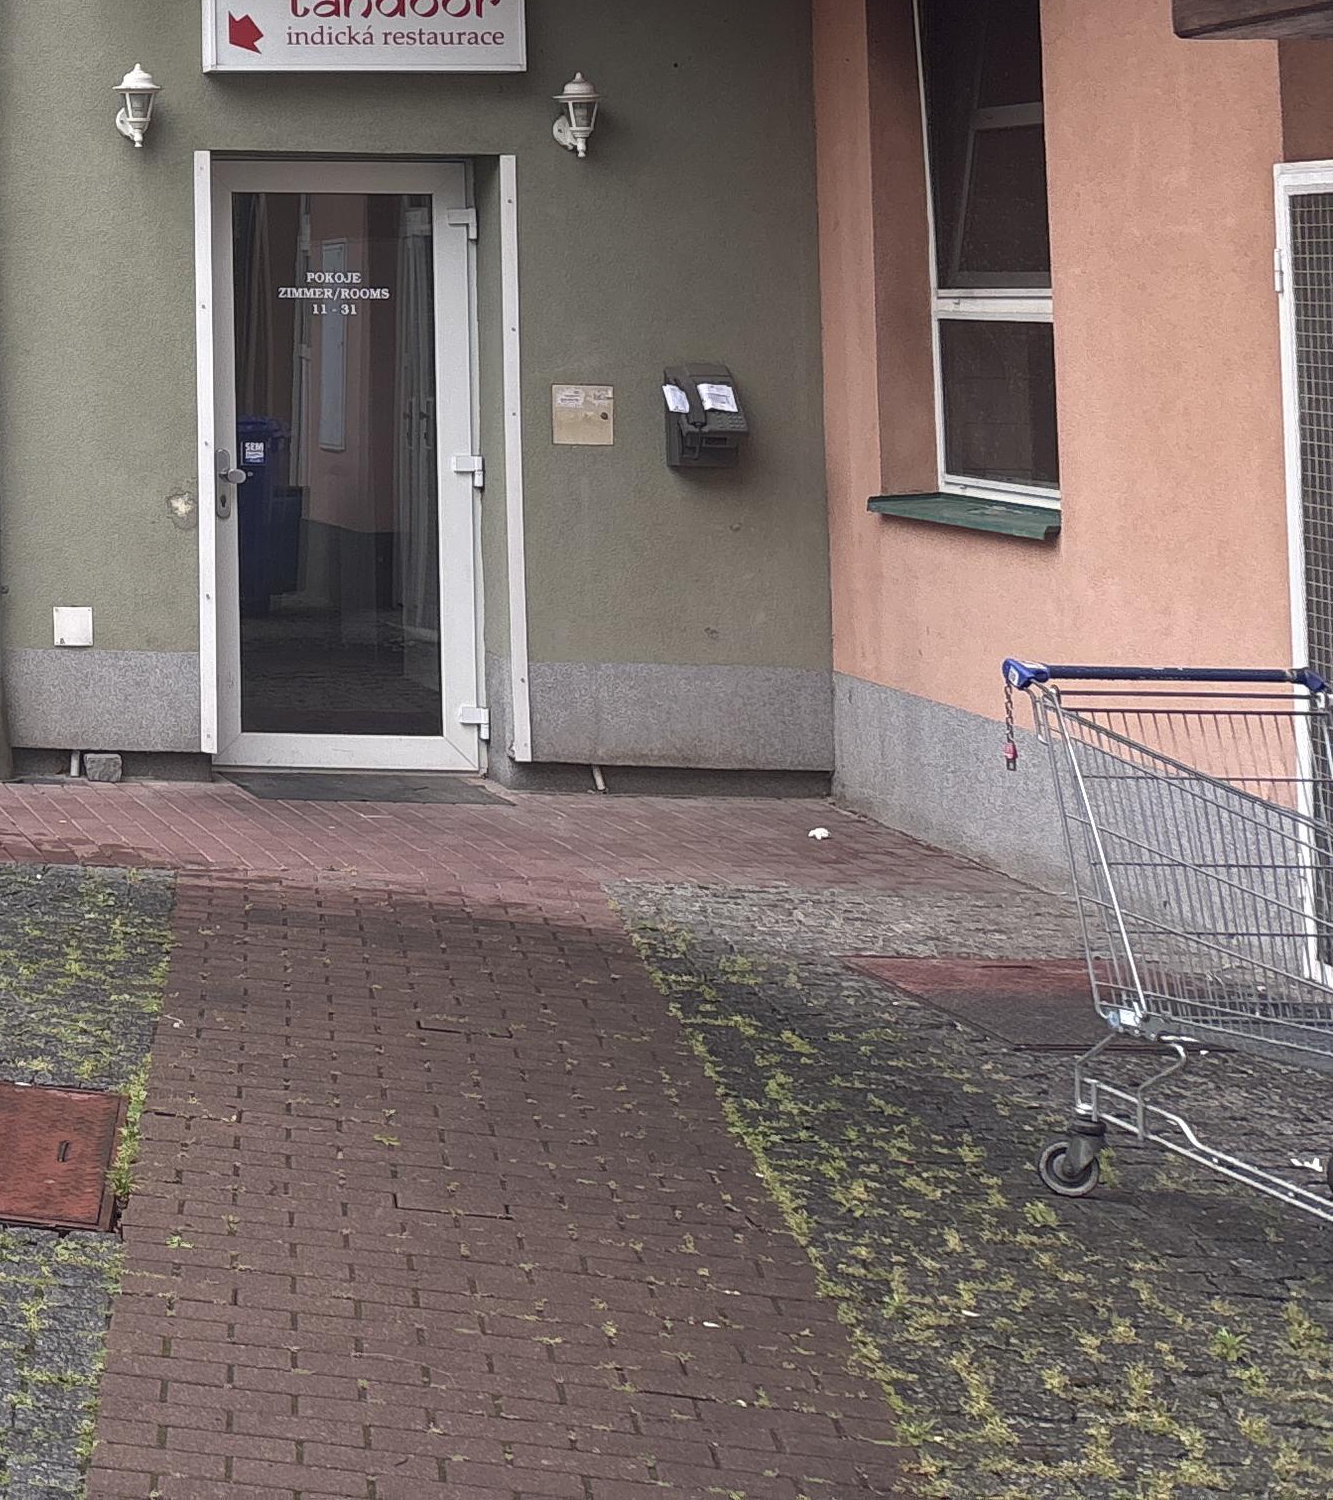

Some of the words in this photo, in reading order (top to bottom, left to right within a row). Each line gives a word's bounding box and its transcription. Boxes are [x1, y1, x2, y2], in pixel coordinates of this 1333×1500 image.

[287, 25, 374, 45] indická
[383, 28, 505, 45] restaurace
[306, 272, 362, 284] POKOJE
[278, 287, 390, 300] ZIMMER/ROOMS
[312, 304, 327, 315] 11
[340, 304, 357, 315] 31
